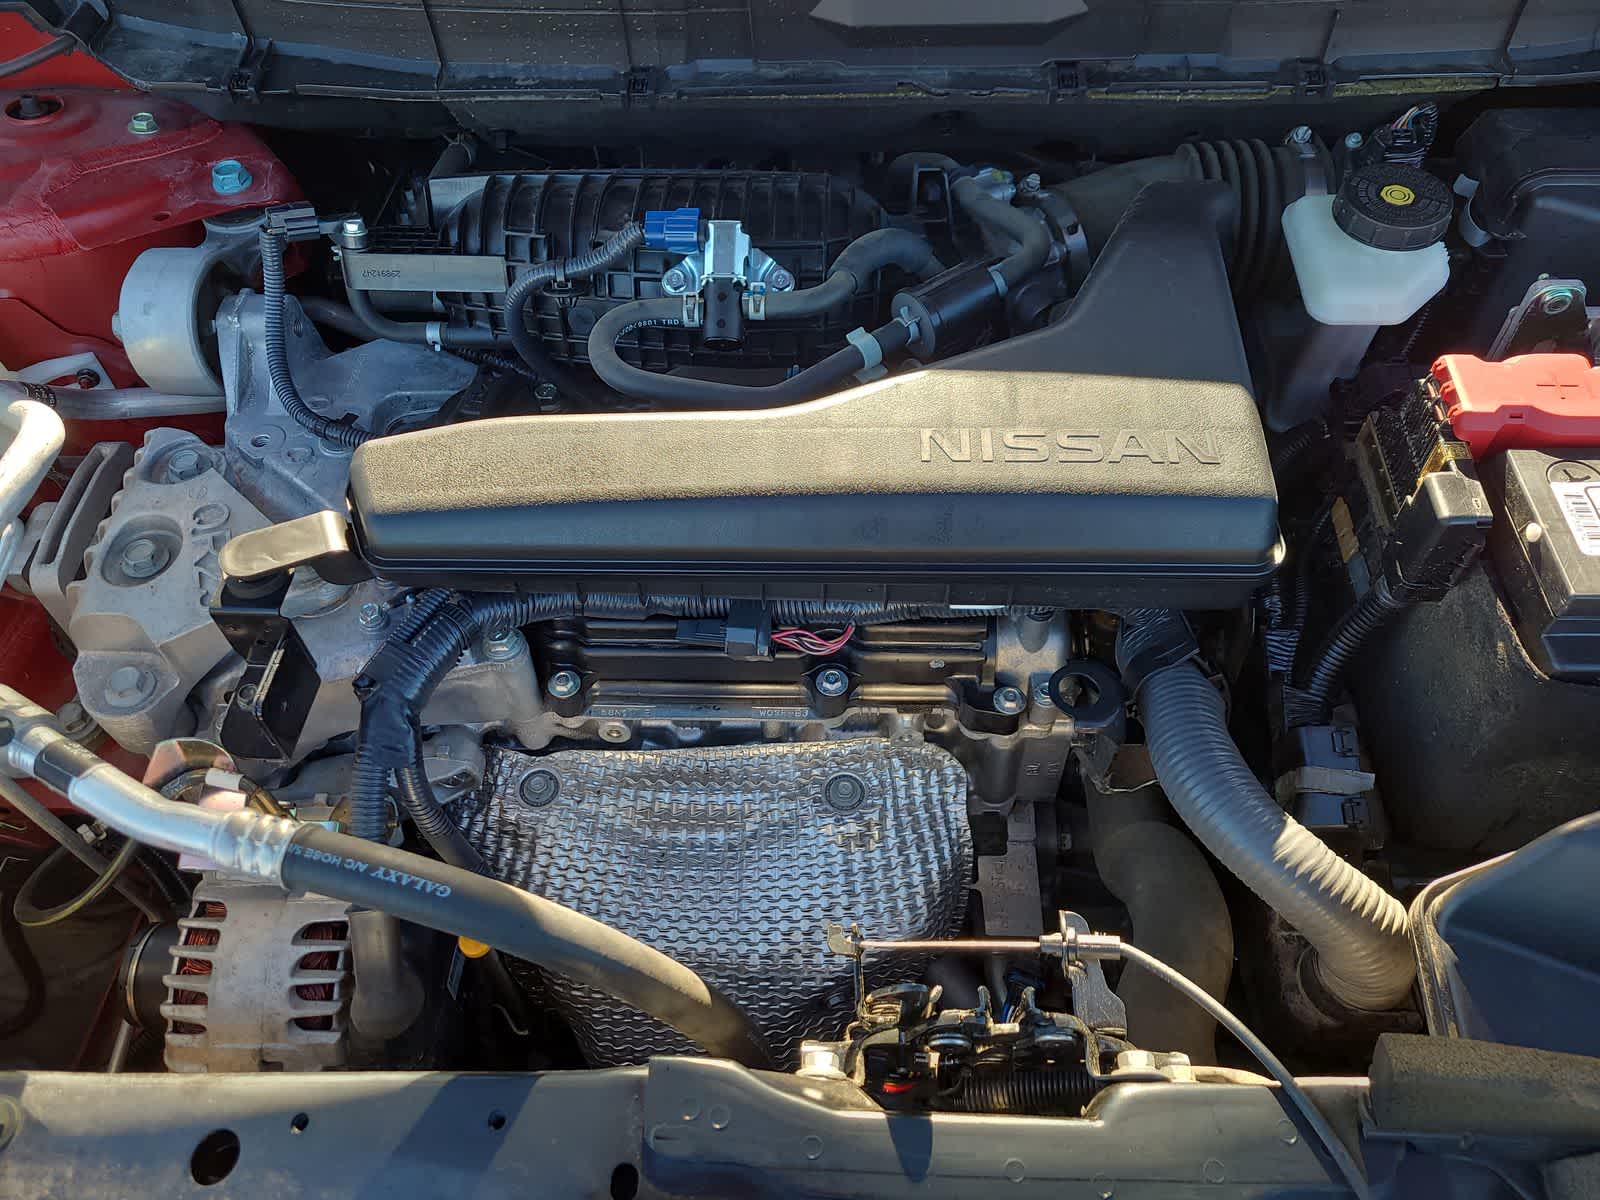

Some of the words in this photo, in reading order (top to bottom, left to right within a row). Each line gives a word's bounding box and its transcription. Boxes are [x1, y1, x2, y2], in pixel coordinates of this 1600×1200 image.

[919, 427, 1221, 465] NISSAN
[303, 847, 342, 866] HOSE
[369, 866, 452, 898] GALAXY
